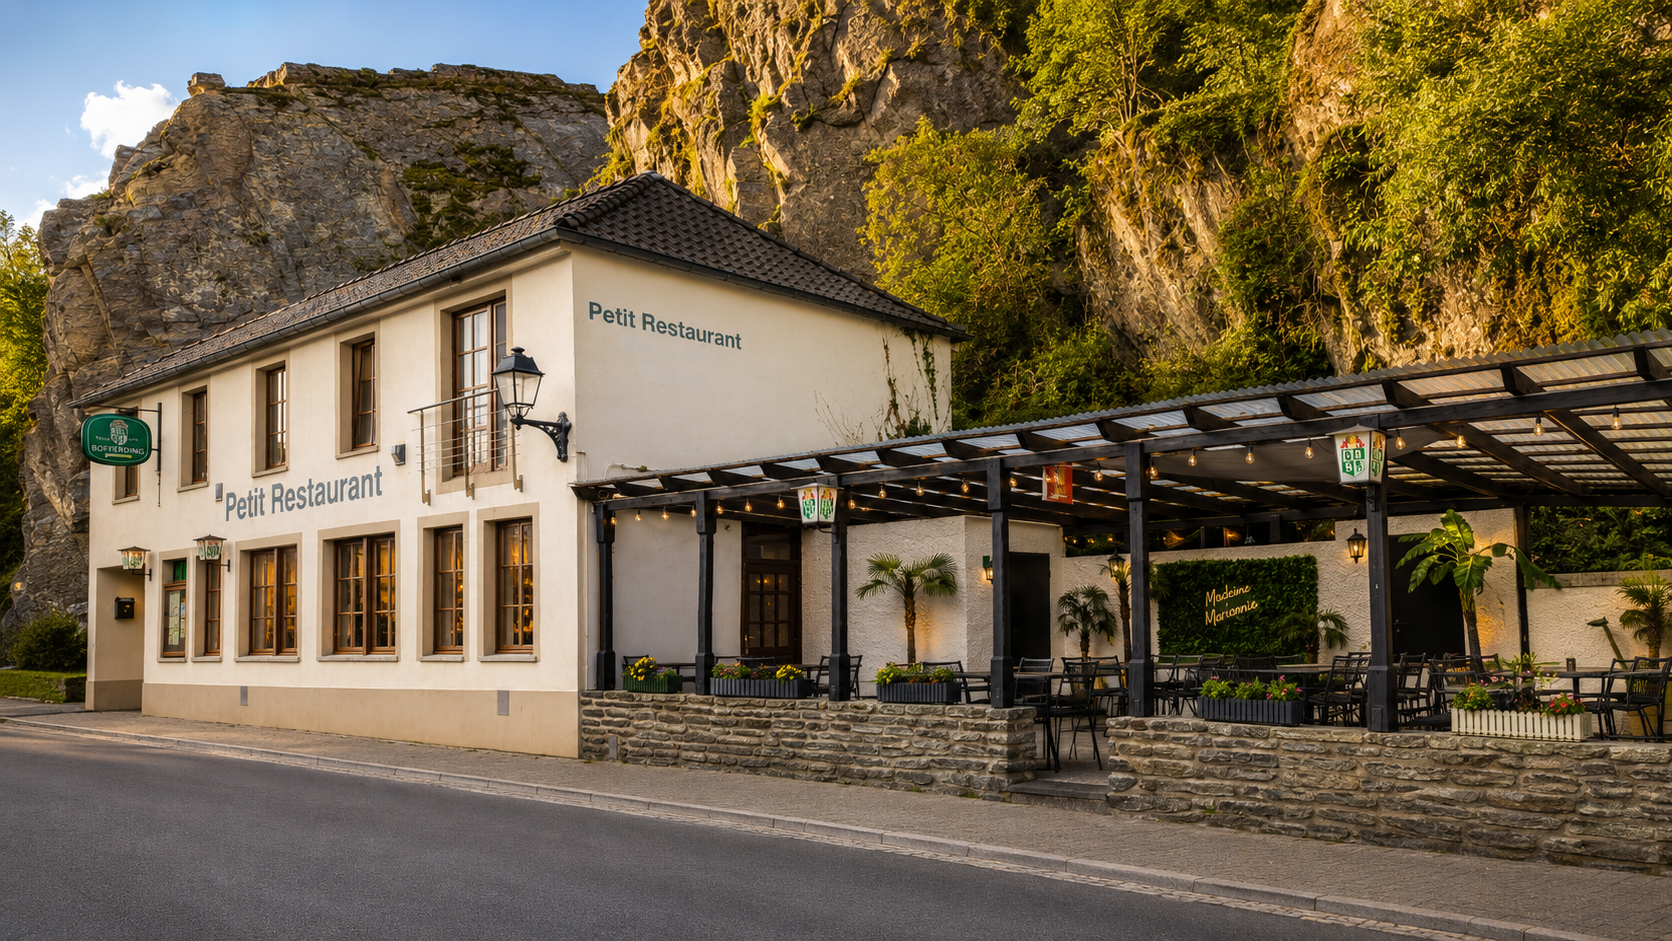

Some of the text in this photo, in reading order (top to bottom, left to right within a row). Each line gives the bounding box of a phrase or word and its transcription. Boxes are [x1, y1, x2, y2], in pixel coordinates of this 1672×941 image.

[589, 301, 742, 350] Petit Restaurant
[225, 465, 383, 522] Petit Restaurant
